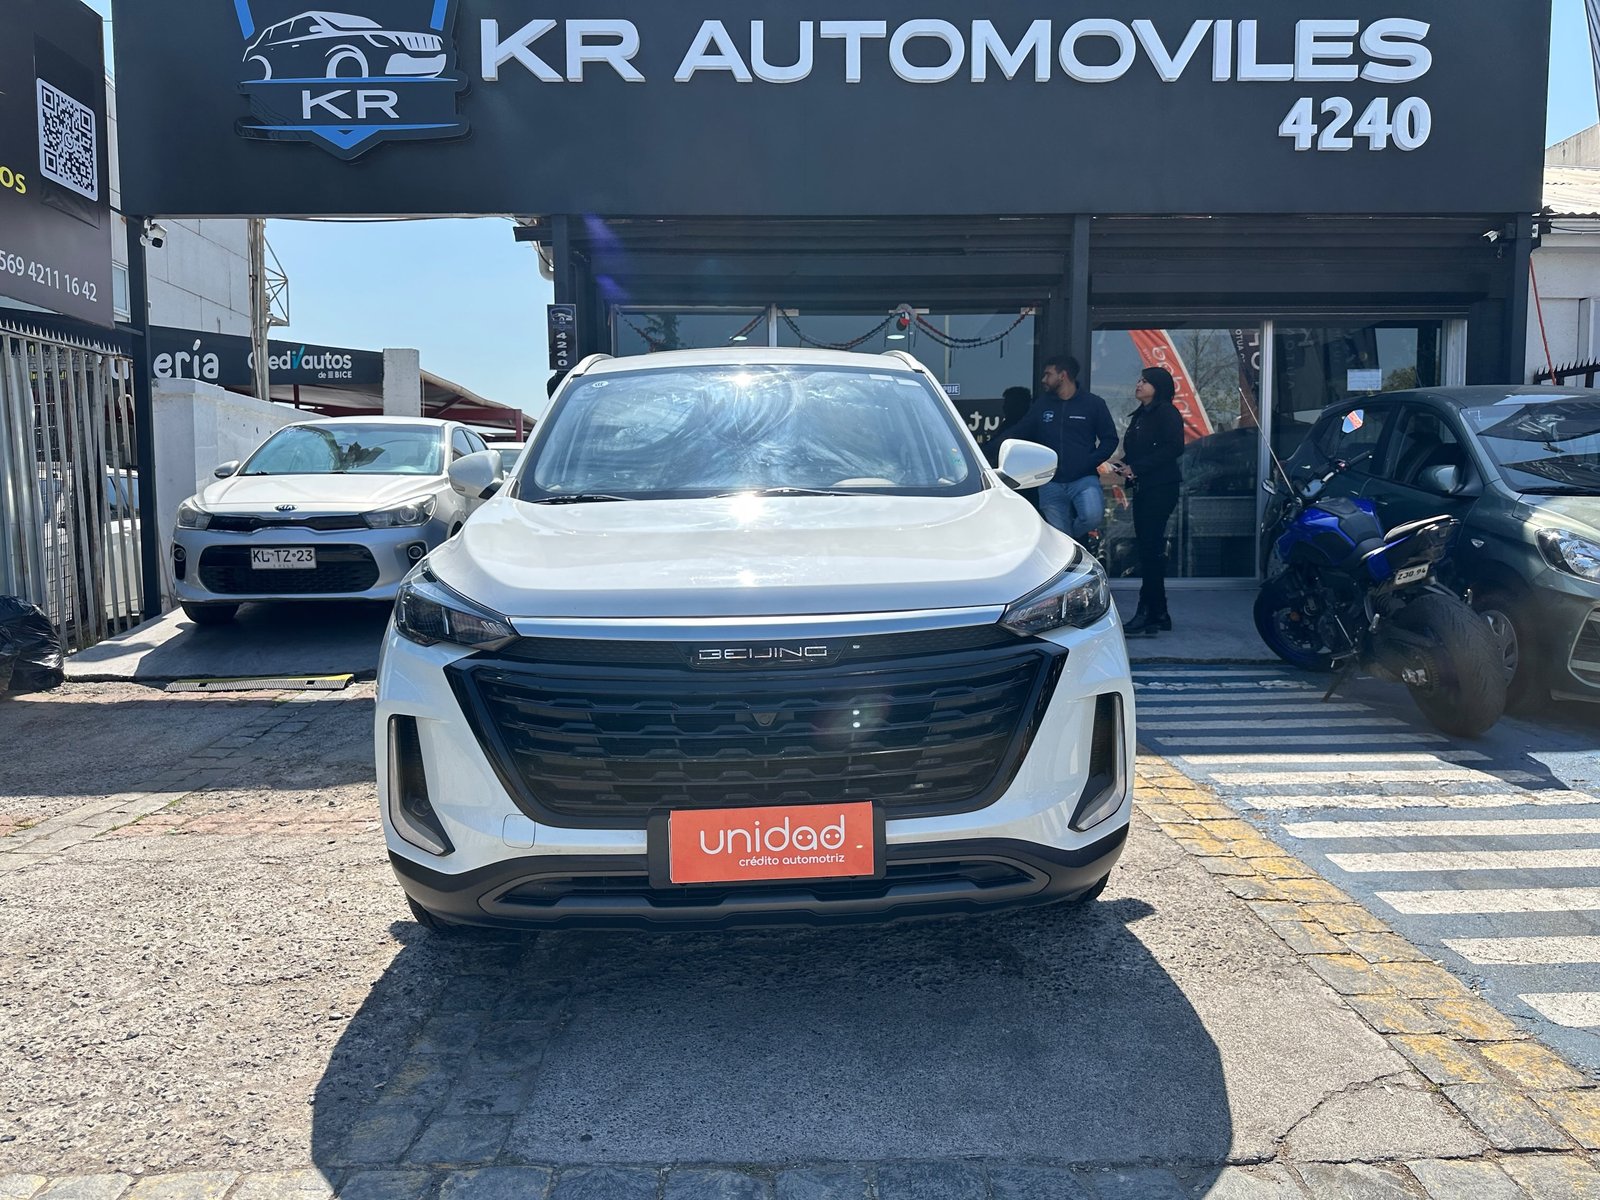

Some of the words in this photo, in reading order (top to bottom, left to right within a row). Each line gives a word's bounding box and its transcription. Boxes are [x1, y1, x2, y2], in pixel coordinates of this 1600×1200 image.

[480, 18, 645, 83] KR
[673, 18, 1432, 84] AUTOMOVILES
[302, 89, 400, 119] KR
[1278, 96, 1432, 152] 4240
[28, 261, 59, 290] 4211
[65, 274, 80, 296] 16
[82, 281, 97, 303] 42
[335, 371, 353, 379] BICE
[698, 646, 827, 660] BEIJING
[700, 814, 845, 855] unidad
[739, 855, 780, 868] crédito
[782, 853, 845, 866] automotriz
